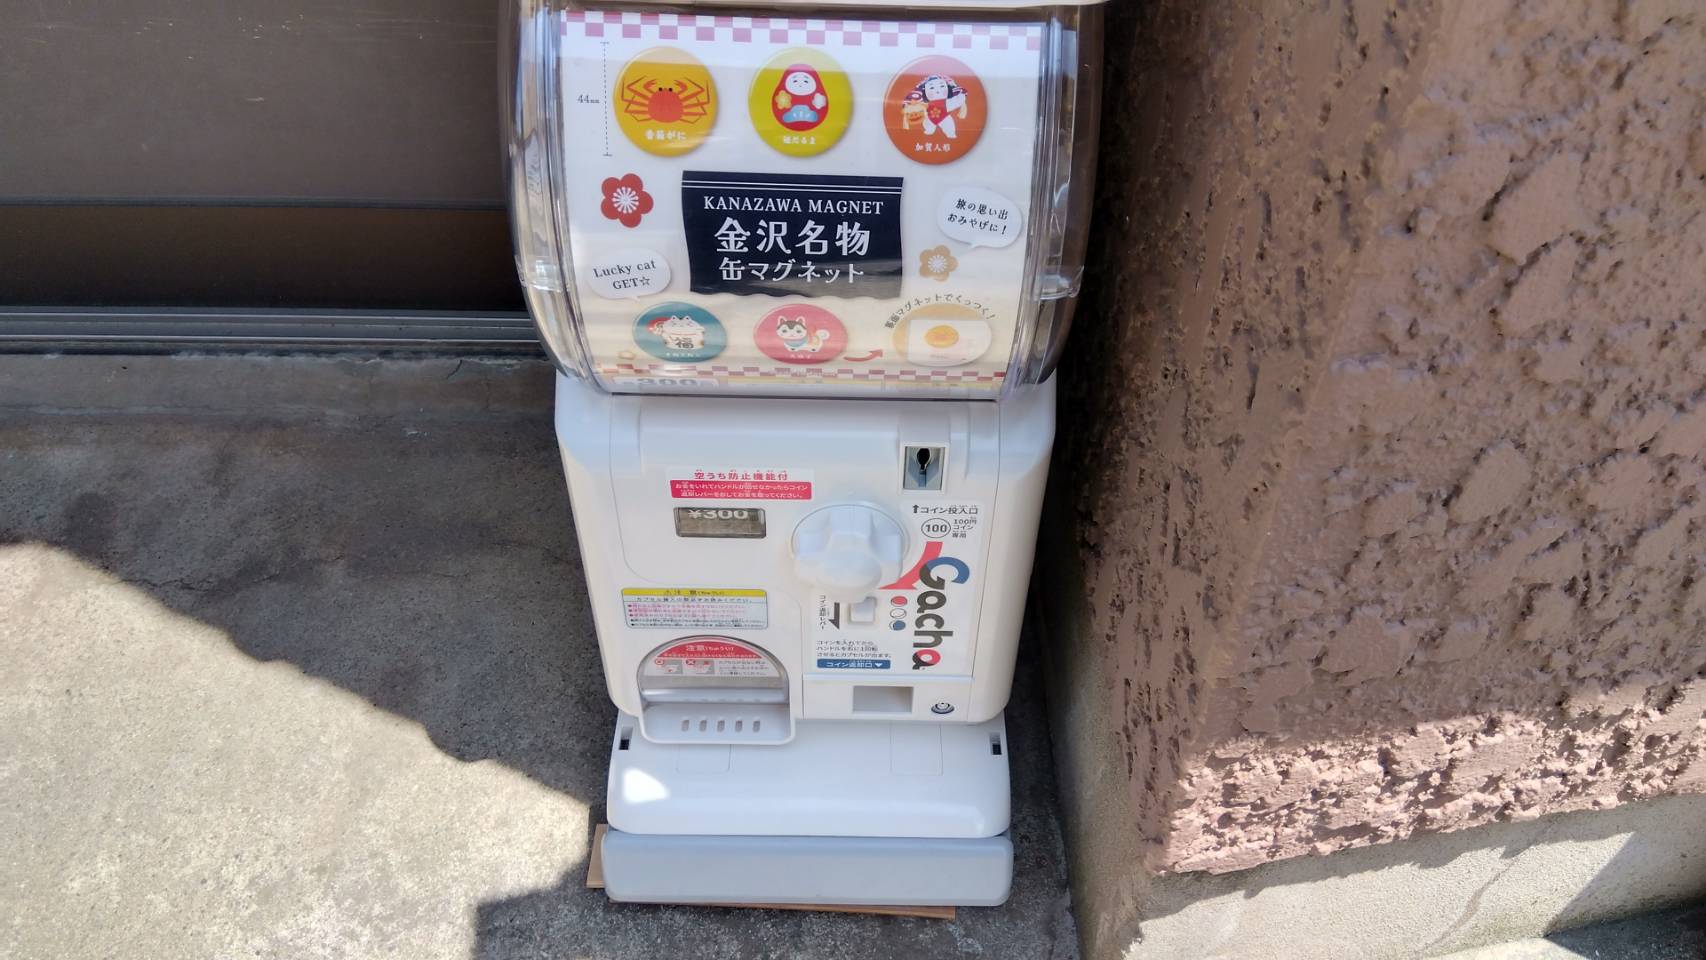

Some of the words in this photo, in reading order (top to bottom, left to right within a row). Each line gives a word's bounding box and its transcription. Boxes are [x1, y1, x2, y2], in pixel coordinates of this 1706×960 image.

[914, 142, 951, 153] 加賀人形
[703, 195, 802, 213] KANAZAWA
[808, 199, 884, 216] MAGNET
[955, 197, 1009, 220] 旅の思い出
[947, 212, 1008, 235] おみやげに!
[714, 216, 871, 256] 金沢名物
[593, 262, 632, 278] Lucky
[636, 259, 657, 271] cat
[719, 256, 865, 284] 缶マグネット
[694, 471, 788, 481] 空うち防止機能付
[920, 506, 978, 515] コイン投入口
[925, 524, 948, 533] 100
[912, 556, 970, 670] Gacha
